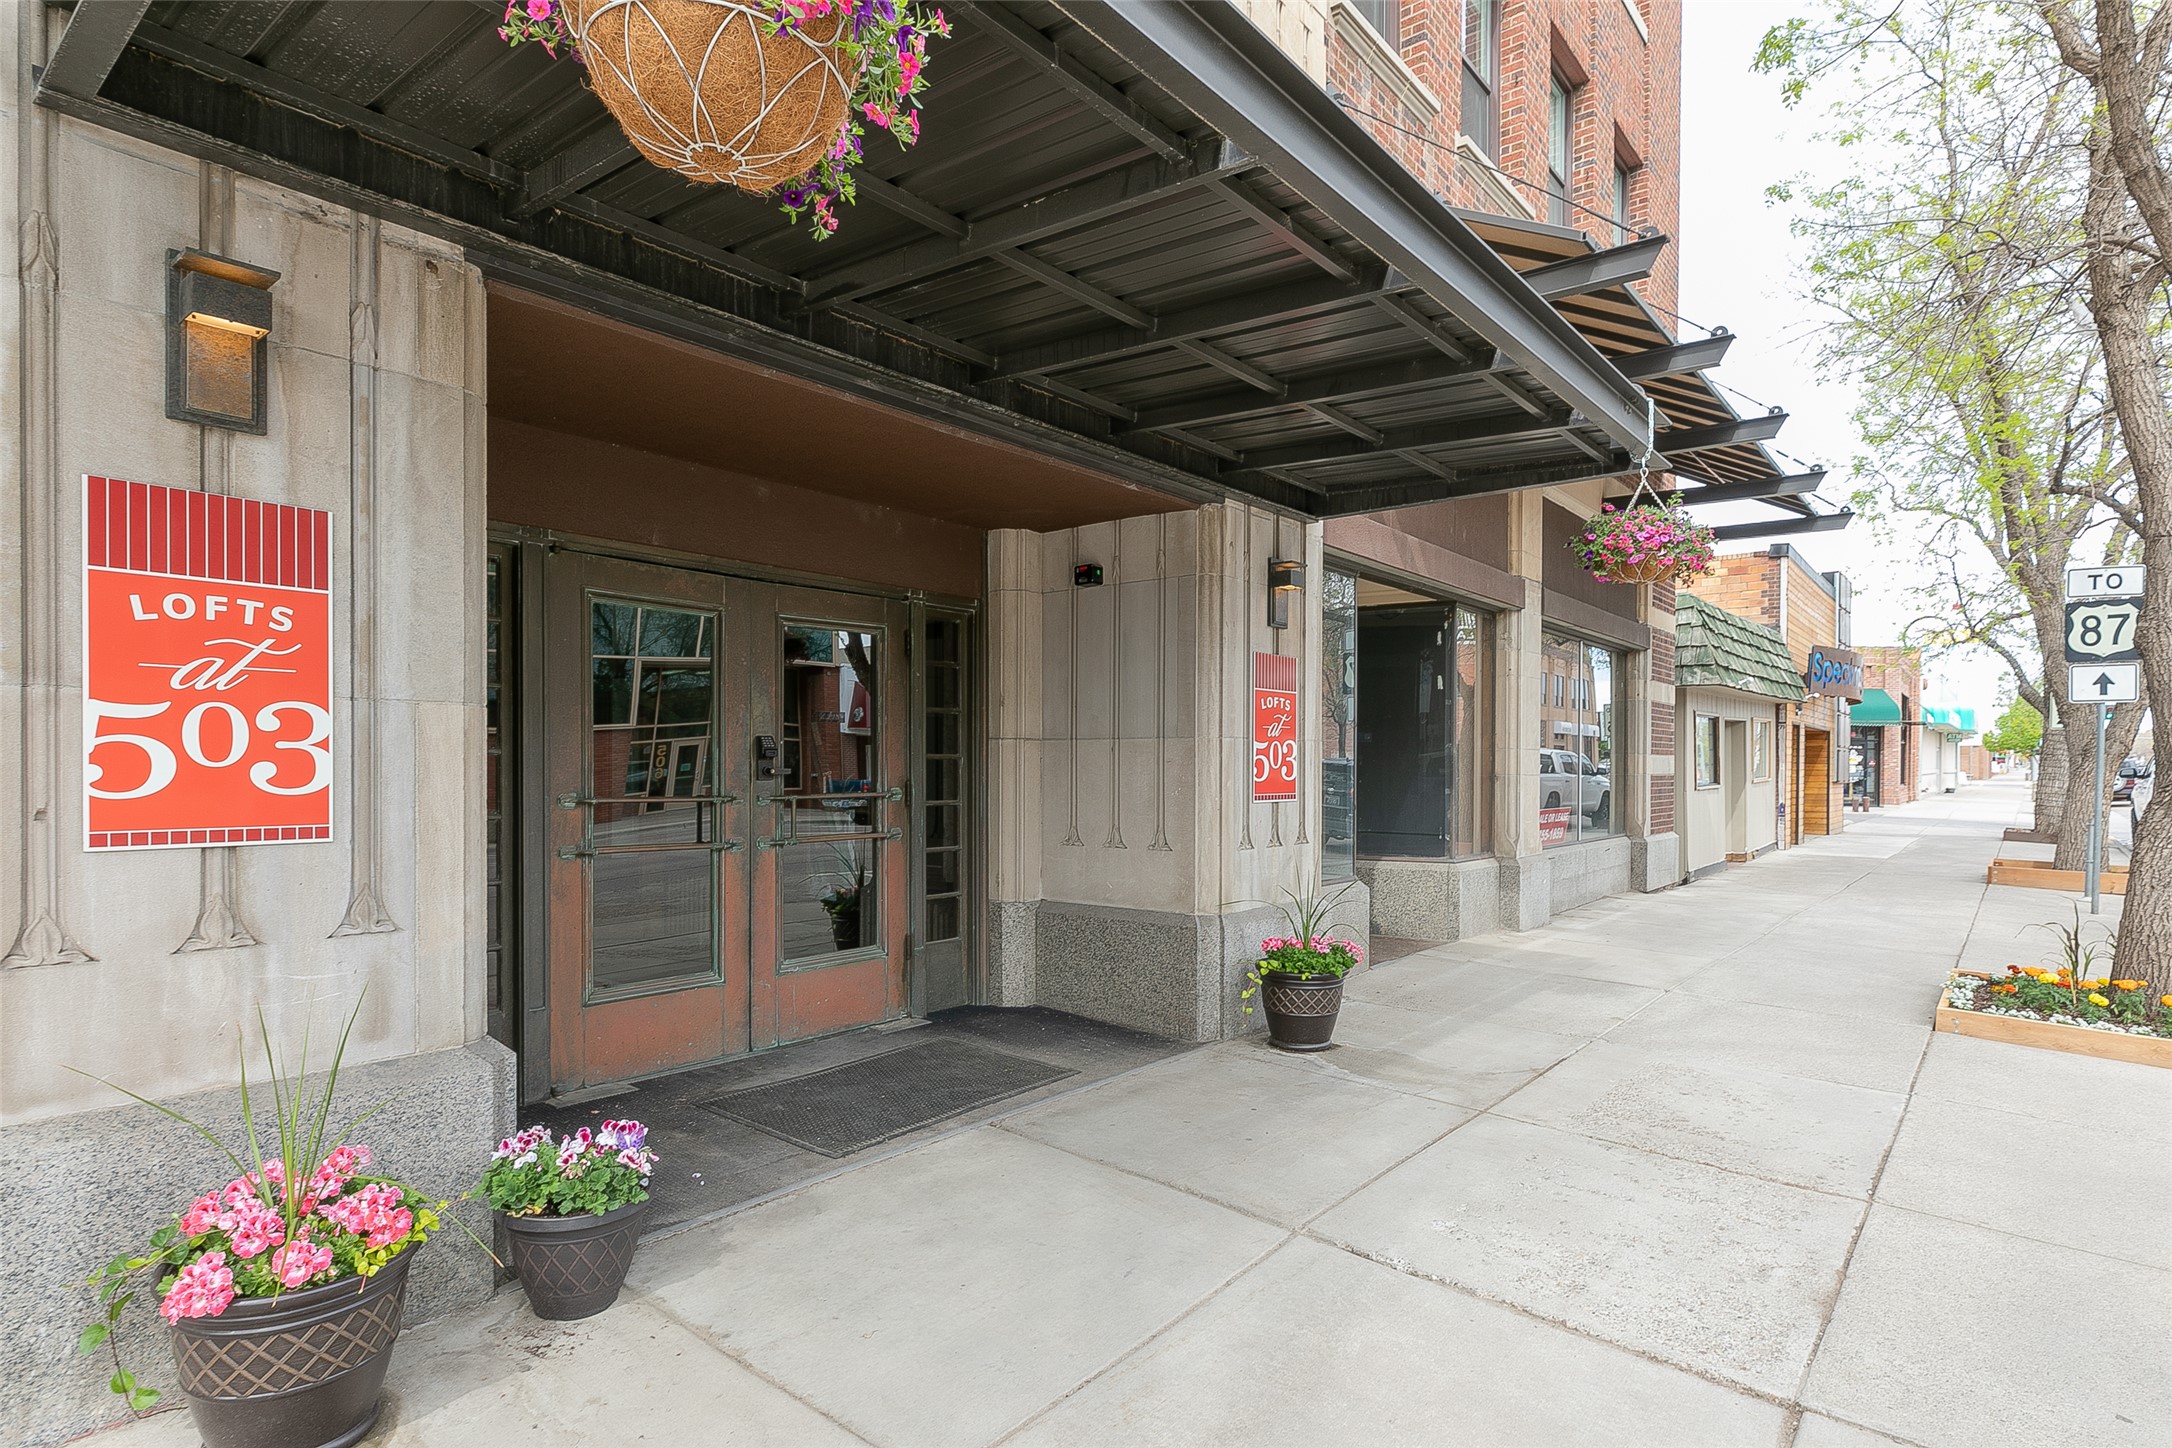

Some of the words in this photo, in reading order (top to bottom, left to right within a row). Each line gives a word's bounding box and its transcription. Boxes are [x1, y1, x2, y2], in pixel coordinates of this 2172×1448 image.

[2087, 573, 2123, 590] TO
[128, 593, 295, 632] LOFTS
[2080, 613, 2131, 647] 87
[170, 638, 302, 691] at
[1260, 696, 1291, 711] LOFTS
[1267, 713, 1292, 737] at
[88, 698, 331, 800] 503
[1254, 739, 1297, 783] 503
